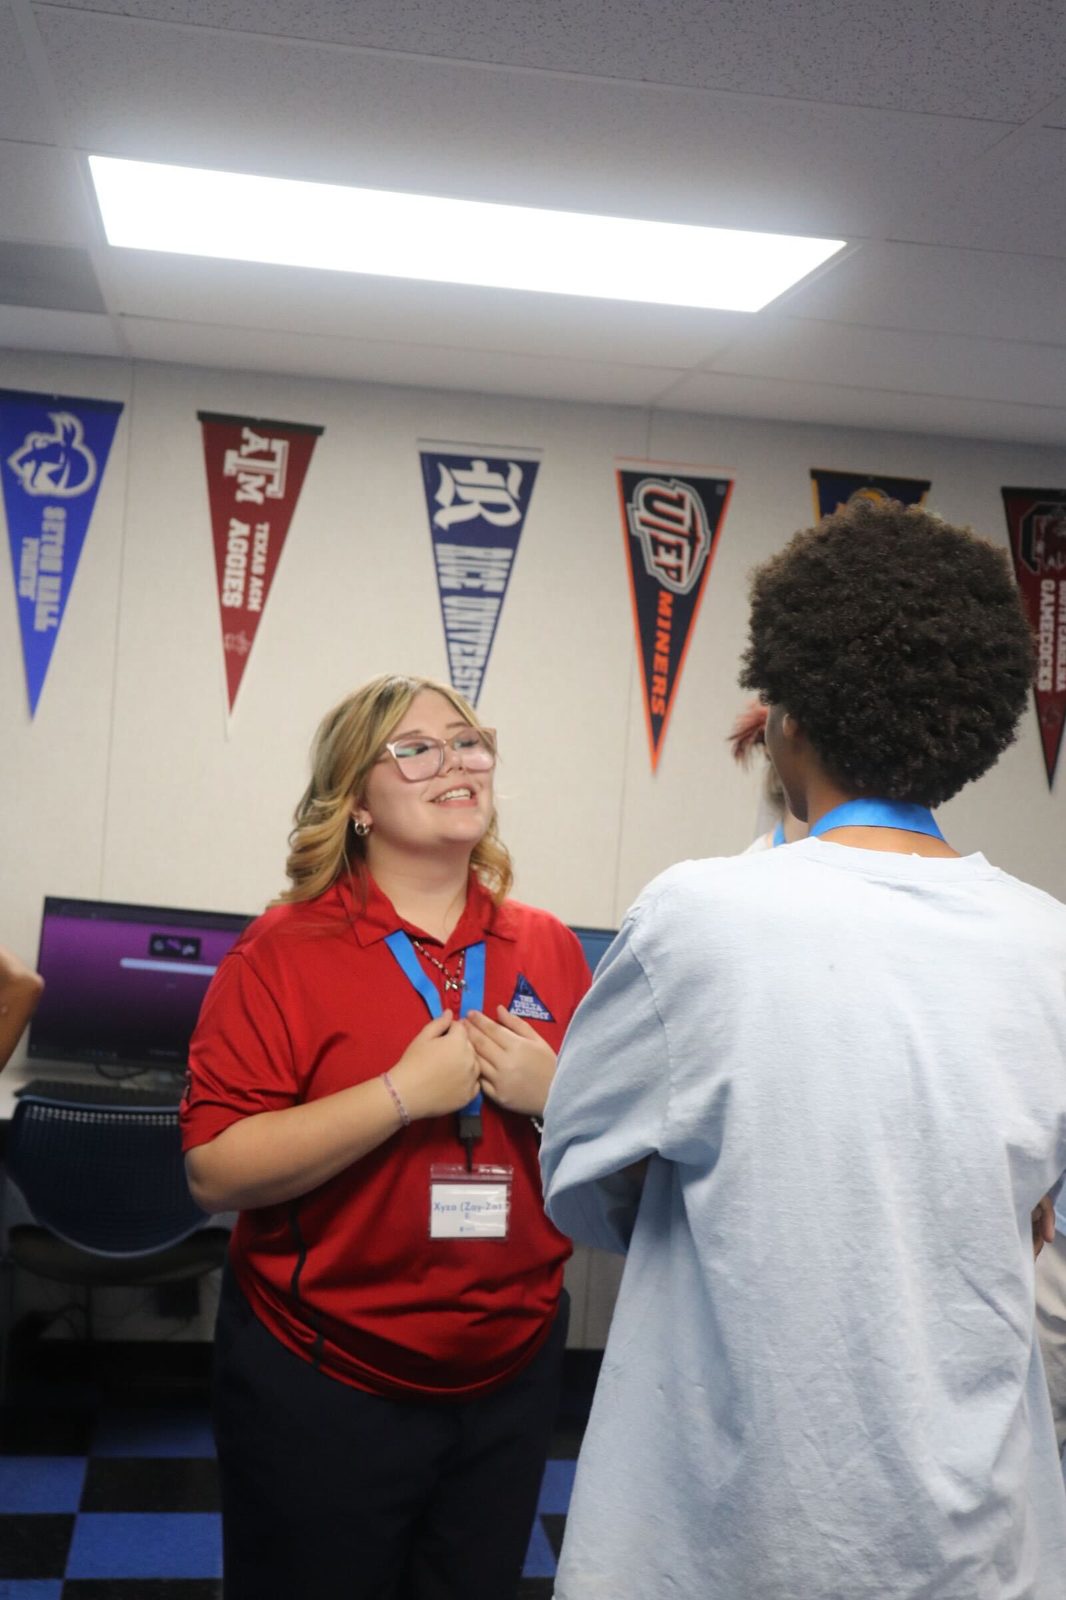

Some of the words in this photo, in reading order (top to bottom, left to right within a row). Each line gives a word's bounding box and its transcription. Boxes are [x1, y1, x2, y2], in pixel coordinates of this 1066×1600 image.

[221, 517, 251, 609] AGGIES
[250, 521, 270, 575] TEXAS
[435, 542, 514, 593] RICE
[636, 488, 704, 587] UTEP
[441, 595, 503, 706] UNIVERSIT
[651, 591, 674, 716] MINERS
[1038, 579, 1055, 692] GAMECOCKS
[509, 1008, 550, 1020] ACADEMY
[513, 999, 543, 1012] DELTA
[518, 994, 534, 1003] THE
